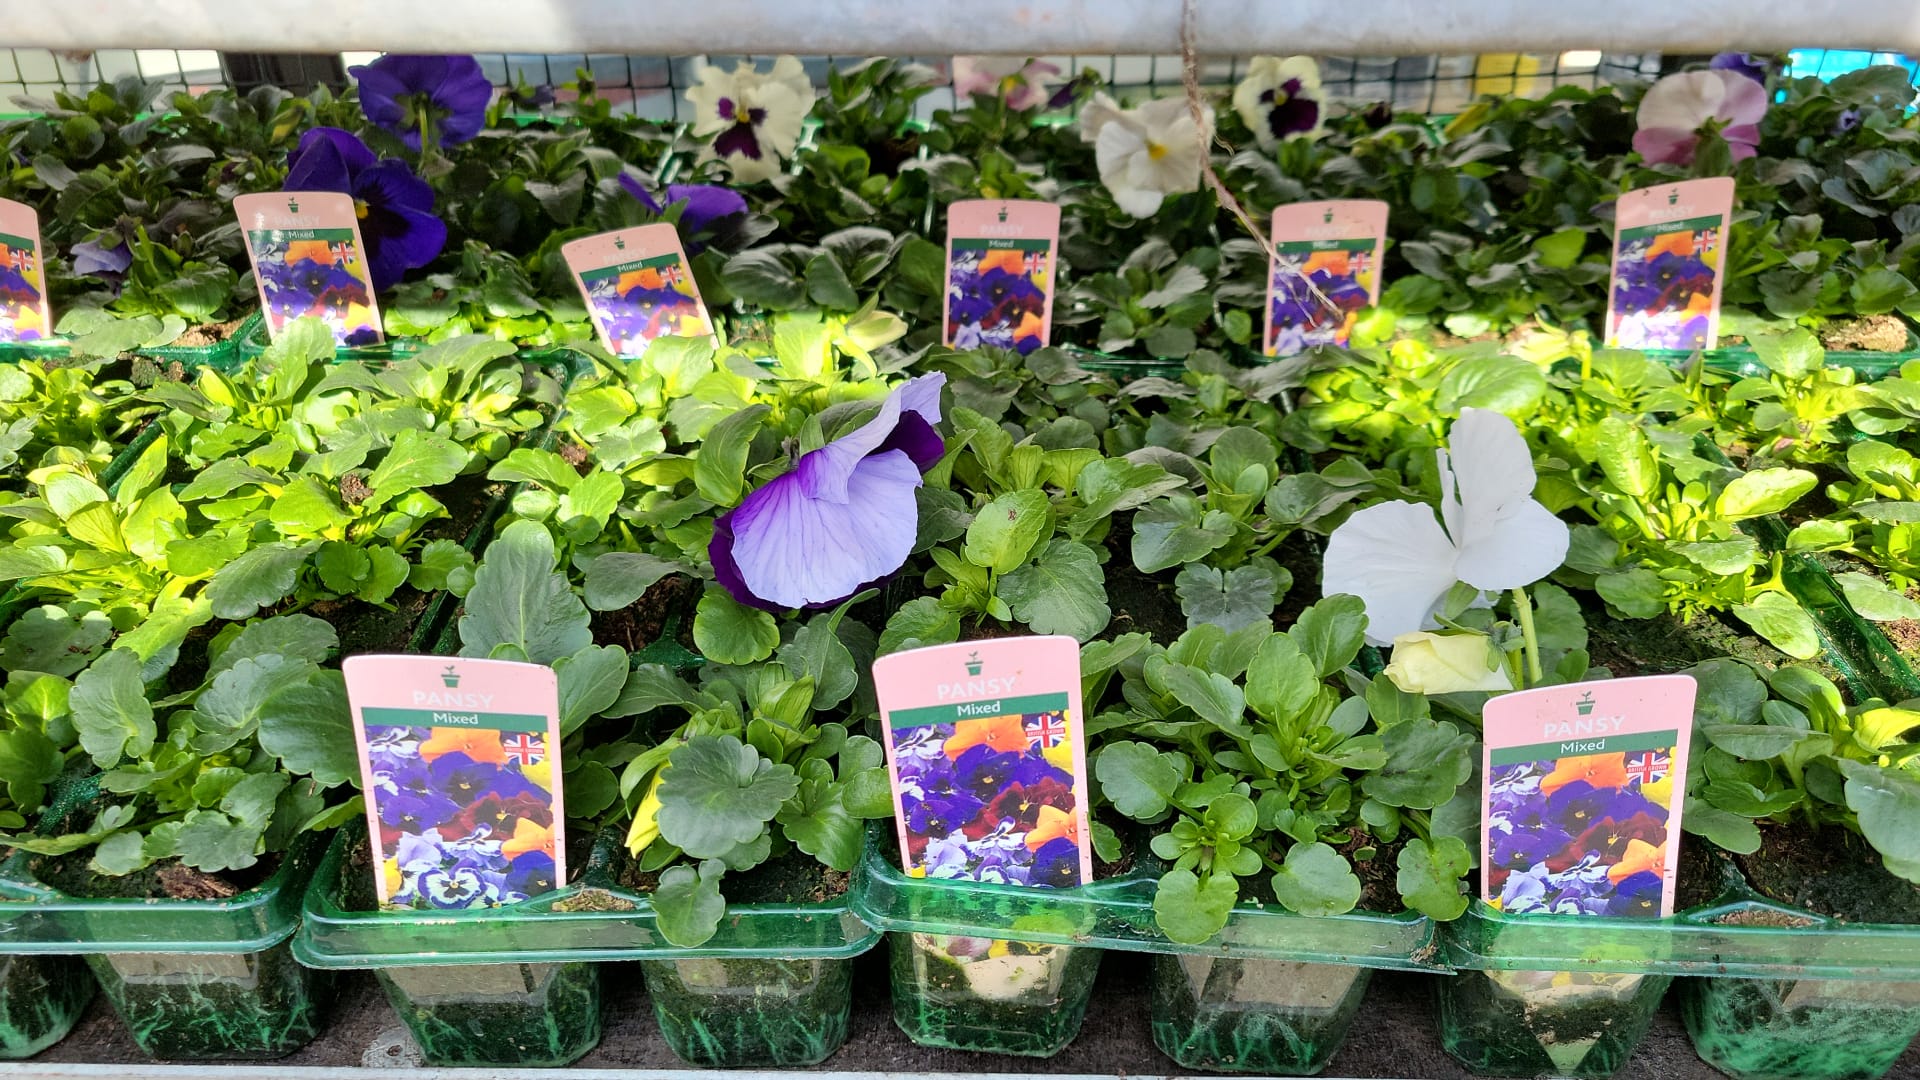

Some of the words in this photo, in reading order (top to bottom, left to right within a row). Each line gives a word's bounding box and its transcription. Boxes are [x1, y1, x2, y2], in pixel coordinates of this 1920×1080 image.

[288, 230, 315, 239] Mixed
[1657, 222, 1684, 232] Mixed
[988, 240, 1014, 248] Mixed
[617, 262, 643, 273] Mixed
[937, 676, 1016, 700] PANSY
[412, 690, 494, 709] PANSY
[956, 700, 1001, 717] Mixed
[433, 711, 479, 725] Mixed
[1543, 715, 1625, 738] PANSY
[1560, 738, 1605, 754] Mixed
